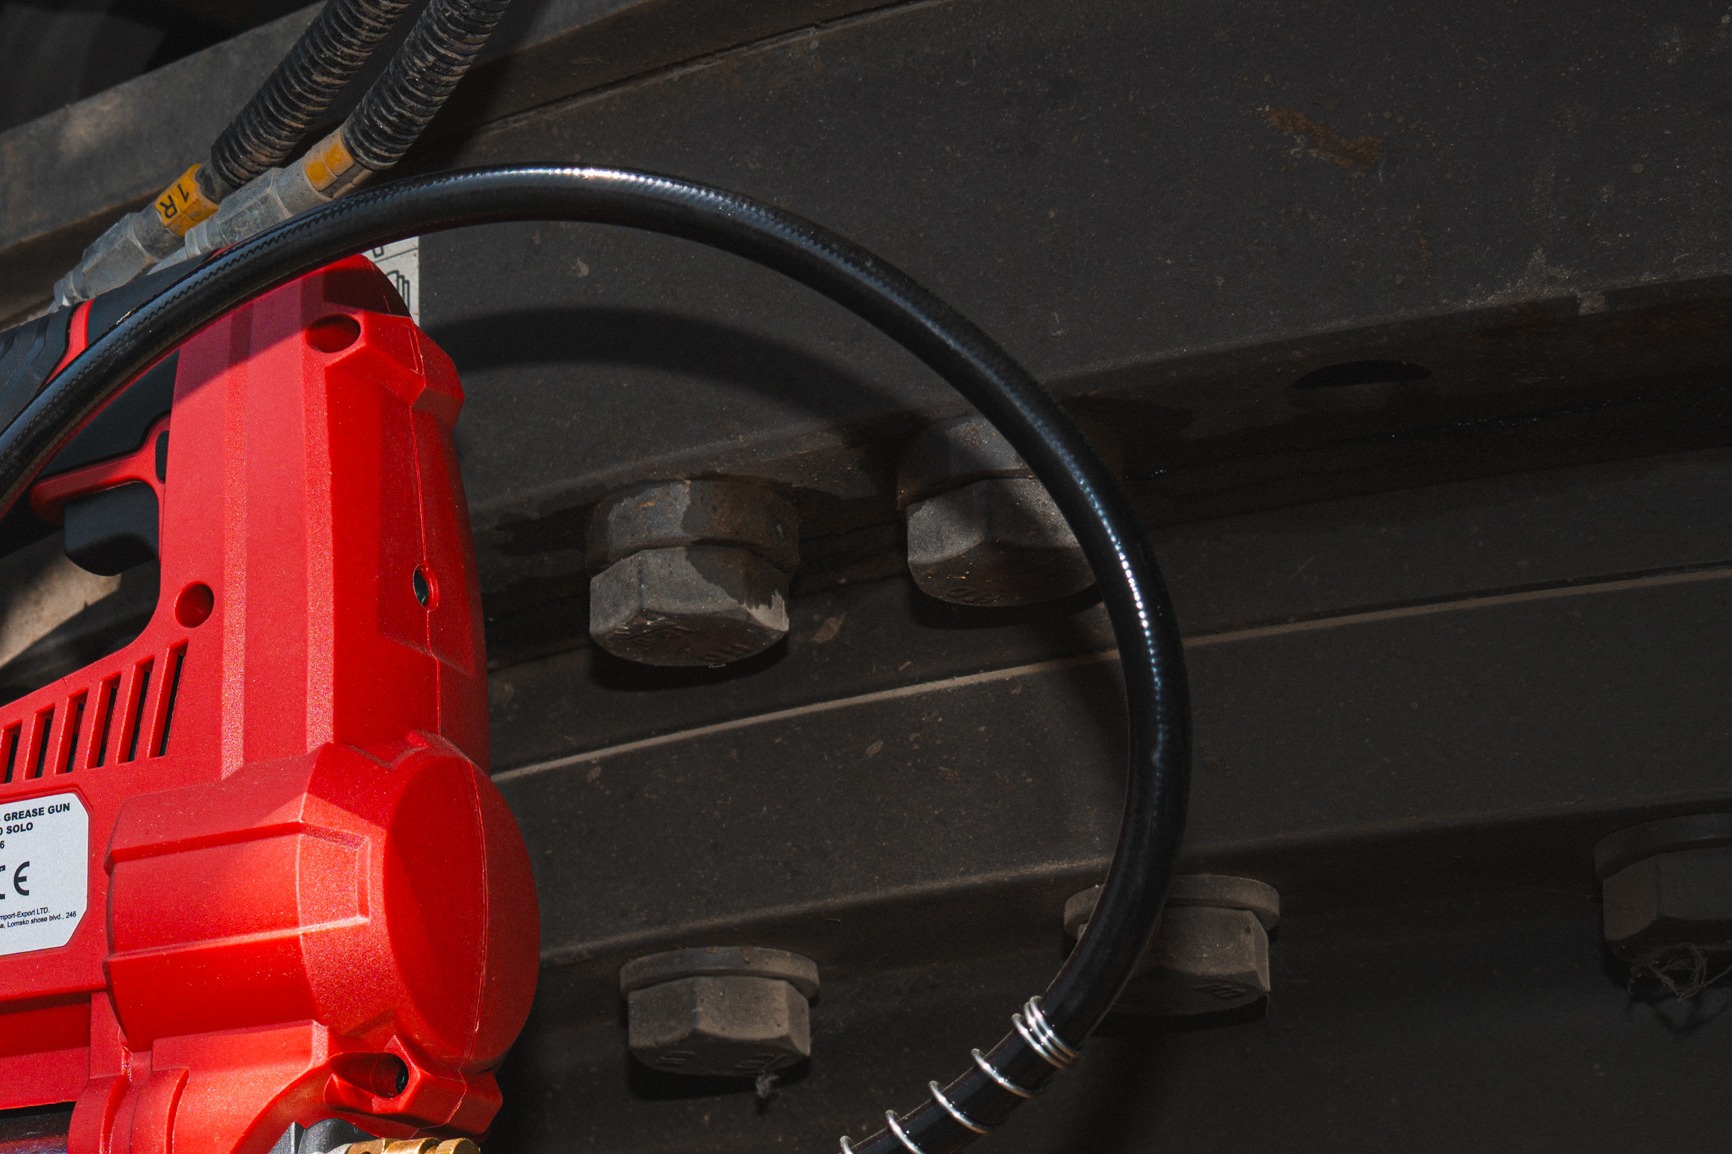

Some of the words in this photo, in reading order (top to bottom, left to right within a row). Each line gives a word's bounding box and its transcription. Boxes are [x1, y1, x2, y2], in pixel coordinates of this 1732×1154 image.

[3, 807, 45, 822] GREASE
[48, 802, 71, 815] GUN
[6, 822, 34, 835] SOLO
[7, 920, 29, 928] Lomsko
